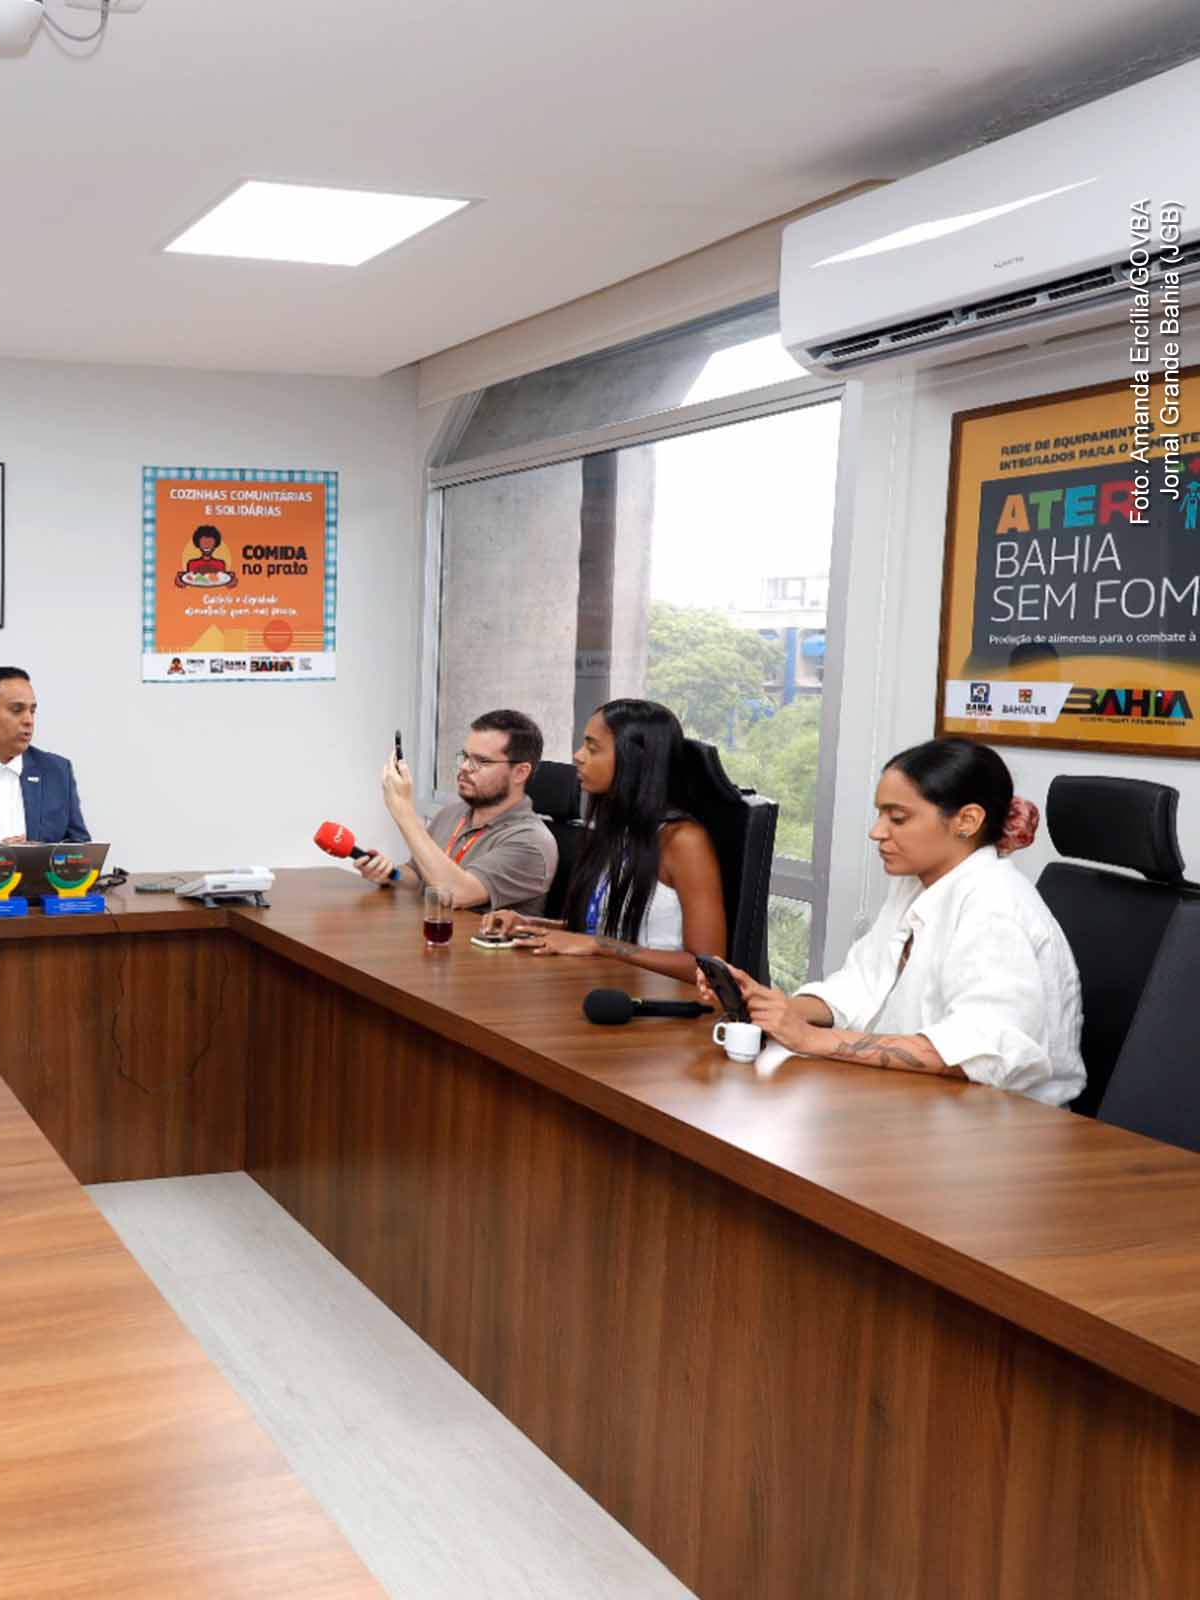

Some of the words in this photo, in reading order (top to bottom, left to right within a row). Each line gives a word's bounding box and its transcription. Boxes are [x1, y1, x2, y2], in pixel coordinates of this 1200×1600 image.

[1034, 439, 1050, 451] DE
[999, 452, 1075, 471] INTEGRADOS
[1079, 444, 1116, 461] PARA
[1119, 442, 1129, 453] O
[169, 488, 228, 501] COZINHAS
[230, 488, 313, 502] COMUNITÁRIAS
[204, 505, 213, 516] E
[216, 504, 282, 517] SOLIDÁRIAS
[996, 480, 1138, 535] ATER
[241, 544, 308, 561] COMIDA
[994, 533, 1122, 579] BAHIA
[241, 563, 262, 576] no
[267, 561, 308, 578] prato
[989, 582, 1076, 623] SEM
[988, 633, 1032, 646] Produção
[1033, 633, 1046, 643] de
[1048, 633, 1098, 644] alimentos
[1099, 634, 1124, 645] para
[1136, 632, 1186, 643] combate
[250, 660, 294, 672] BAHIA
[1061, 687, 1193, 719] BAHIA
